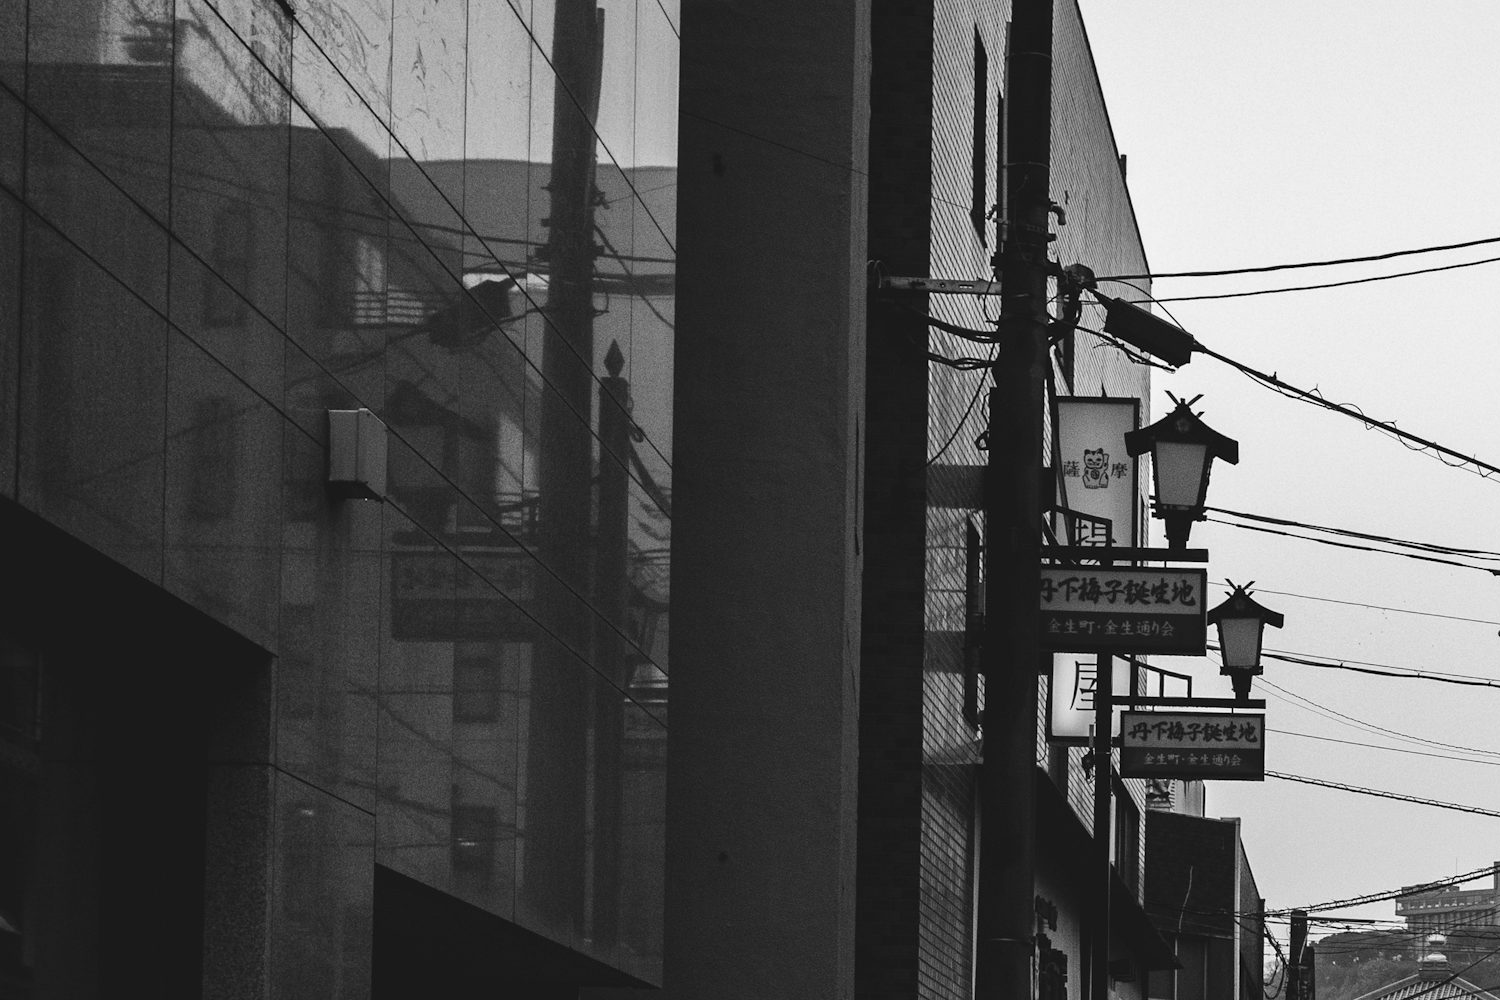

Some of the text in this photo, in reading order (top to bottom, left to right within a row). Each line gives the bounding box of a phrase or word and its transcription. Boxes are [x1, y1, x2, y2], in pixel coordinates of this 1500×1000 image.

[1128, 721, 1259, 743] 丹下梅子誕生地
